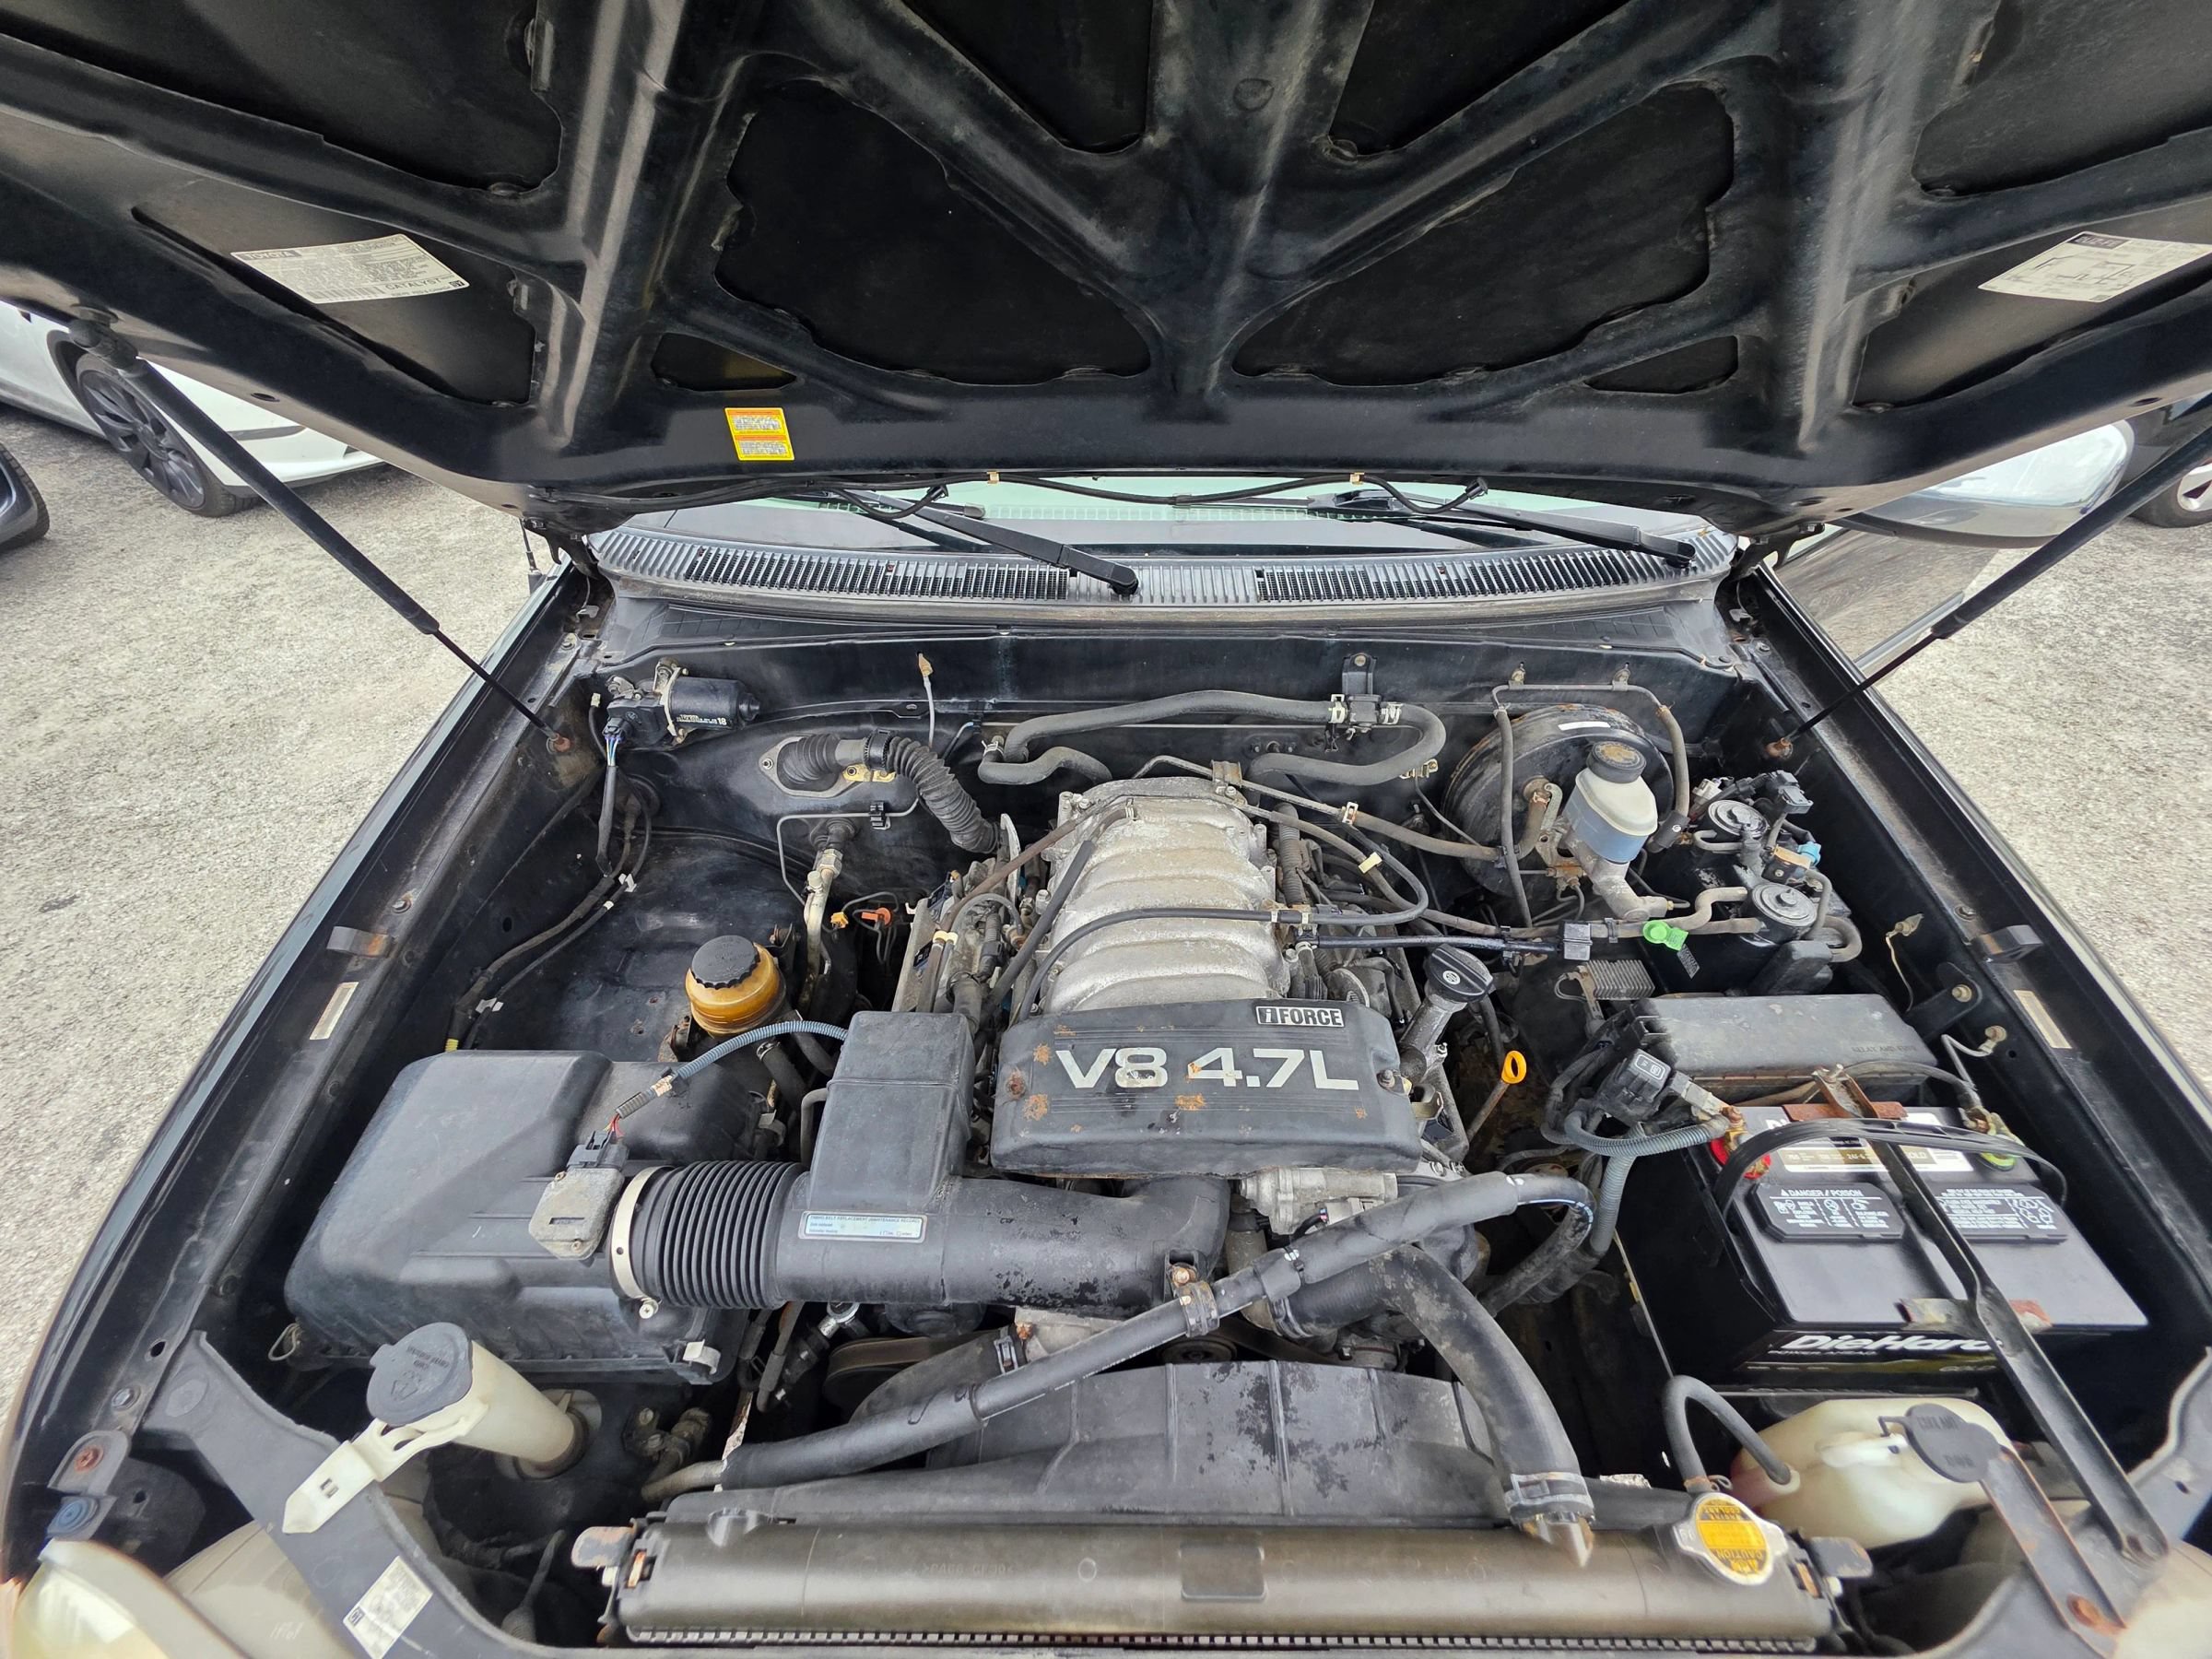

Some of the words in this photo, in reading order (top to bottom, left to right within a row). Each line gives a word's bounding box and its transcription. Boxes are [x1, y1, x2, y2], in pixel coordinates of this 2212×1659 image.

[244, 250, 295, 260] TOYOTA
[385, 277, 441, 290] CATALYST
[1055, 1047, 1168, 1088] V8
[1187, 1047, 1359, 1090] 4.7L
[1831, 1189, 1864, 1197] POISON
[1715, 1548, 1764, 1559] CAUTION
